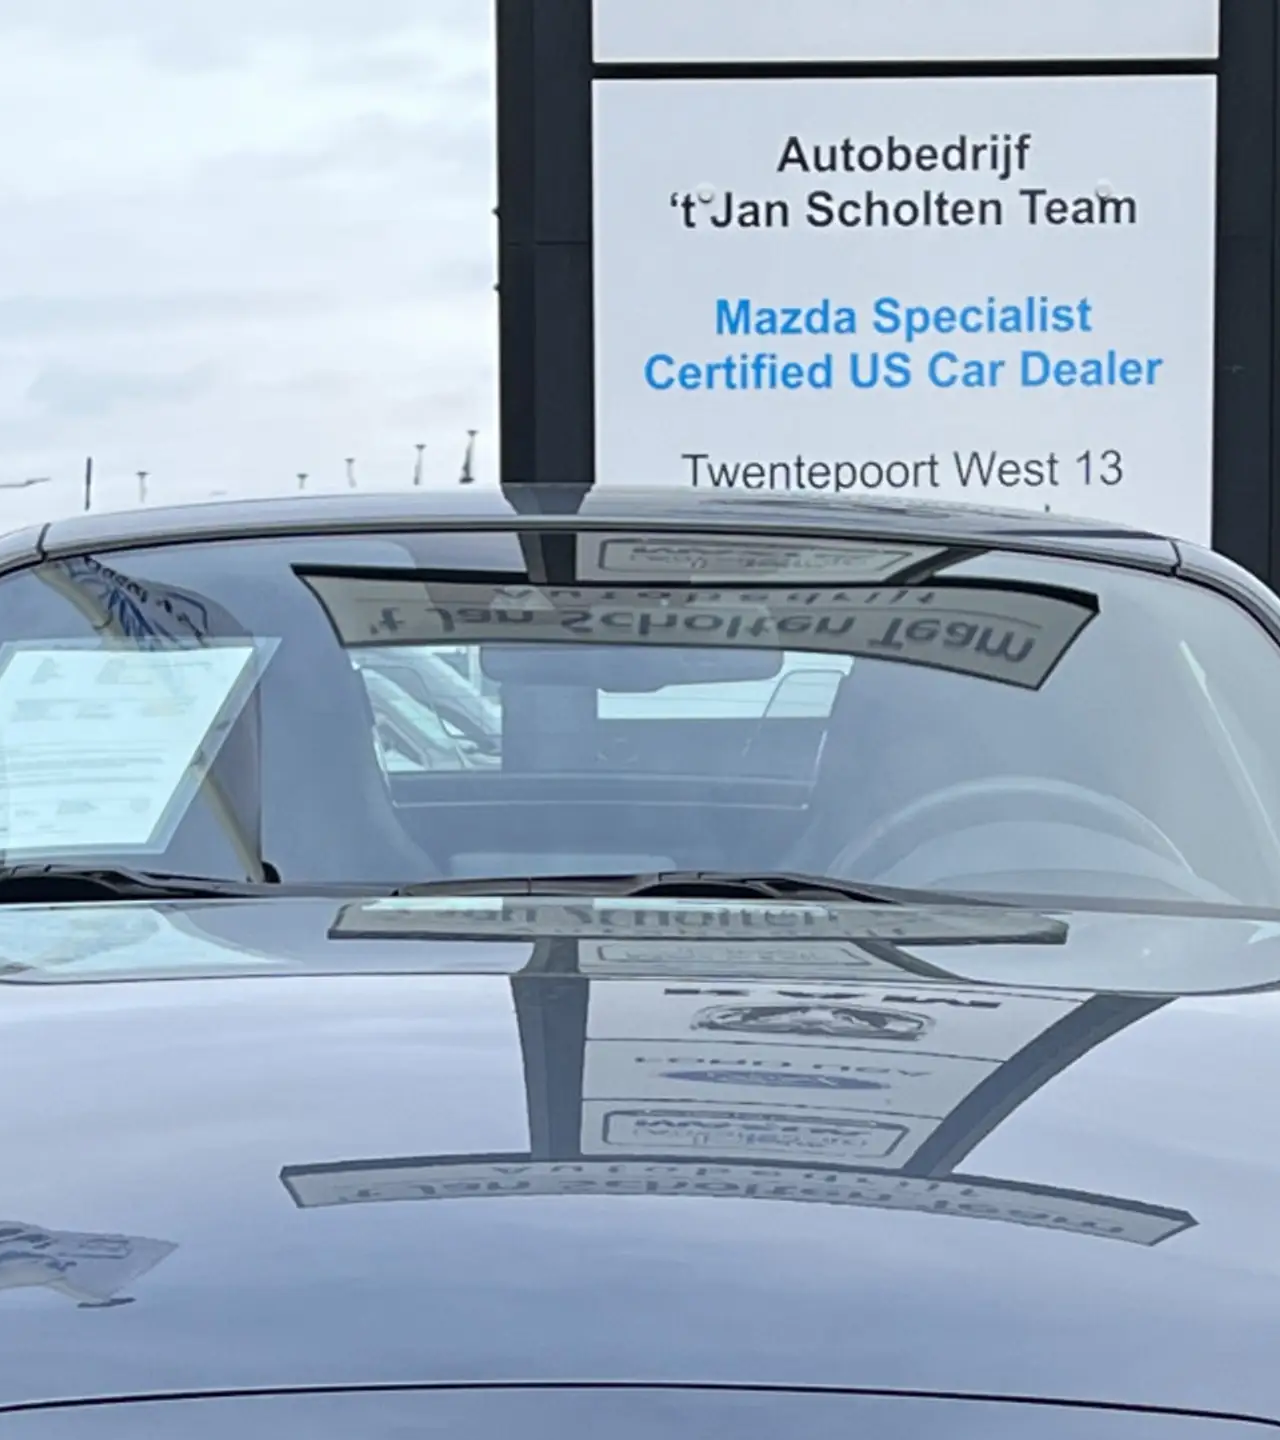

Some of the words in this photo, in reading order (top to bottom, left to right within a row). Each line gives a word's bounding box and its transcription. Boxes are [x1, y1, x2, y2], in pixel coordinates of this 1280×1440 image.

[776, 133, 1032, 181] Autobedrijf
[709, 192, 789, 228] Jan
[806, 189, 1002, 228] Scholten
[1019, 188, 1136, 225] Team
[716, 299, 857, 336] Mazda
[873, 296, 1092, 343] Specialist
[644, 352, 833, 391] Certified
[850, 352, 912, 389] US
[928, 351, 1005, 388] Car
[1021, 350, 1164, 387] Dealer
[681, 453, 940, 491] Twentepoort
[954, 451, 1059, 487] West
[1076, 450, 1123, 486] 13
